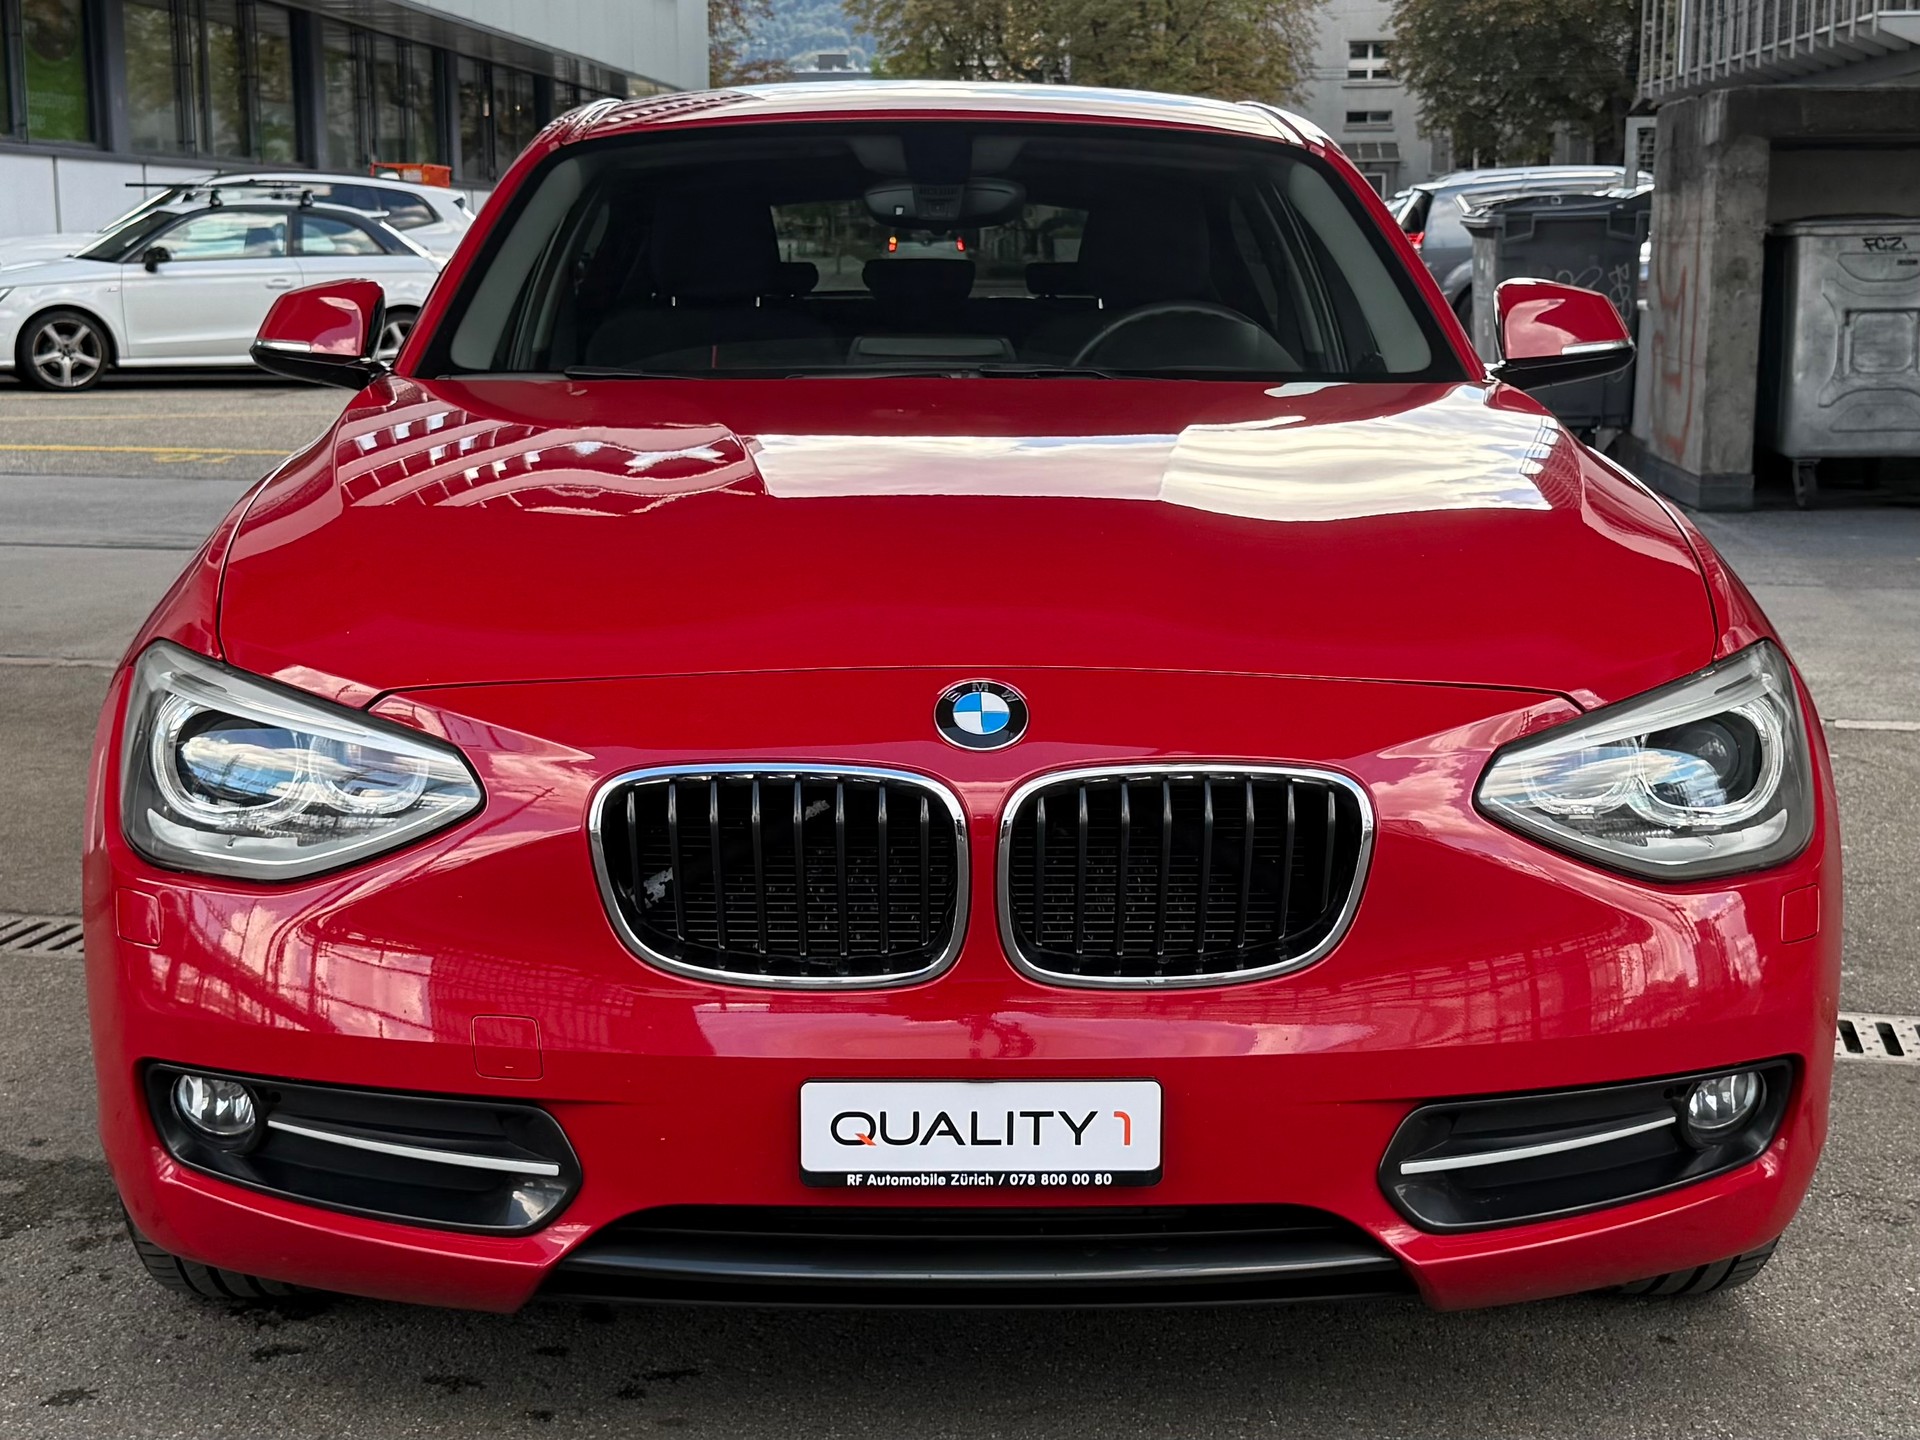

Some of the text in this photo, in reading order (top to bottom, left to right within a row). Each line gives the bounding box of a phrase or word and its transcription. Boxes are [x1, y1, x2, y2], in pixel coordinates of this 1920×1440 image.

[944, 682, 1020, 703] BMW
[830, 1110, 1131, 1146] QUALITY 1
[846, 1173, 1113, 1186] RF Automobile Zürich / 078 800 00 80
